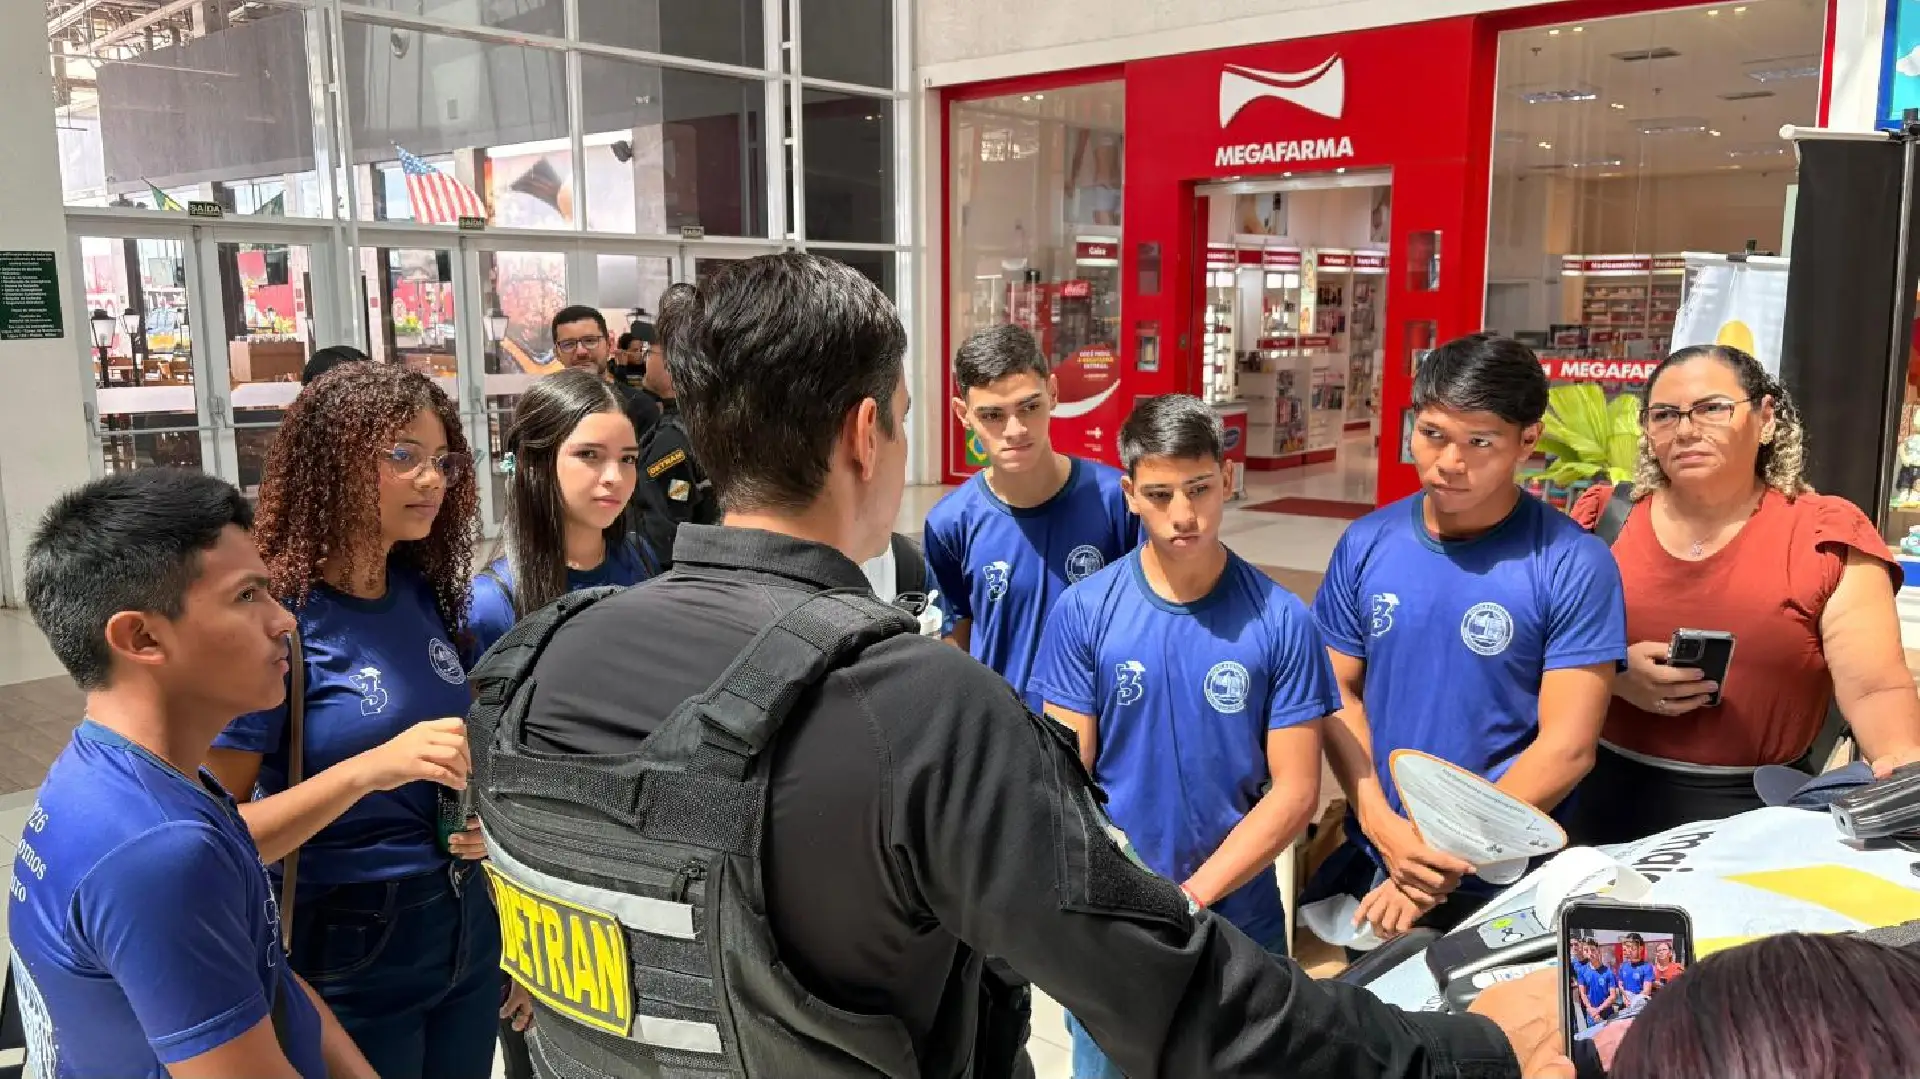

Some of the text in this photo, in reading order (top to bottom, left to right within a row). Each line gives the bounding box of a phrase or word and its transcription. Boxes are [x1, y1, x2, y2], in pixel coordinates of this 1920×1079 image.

[1214, 135, 1355, 167] MEGAFARMA
[1560, 360, 1660, 379] MEGAFAR
[492, 874, 625, 1021] DETRAN
